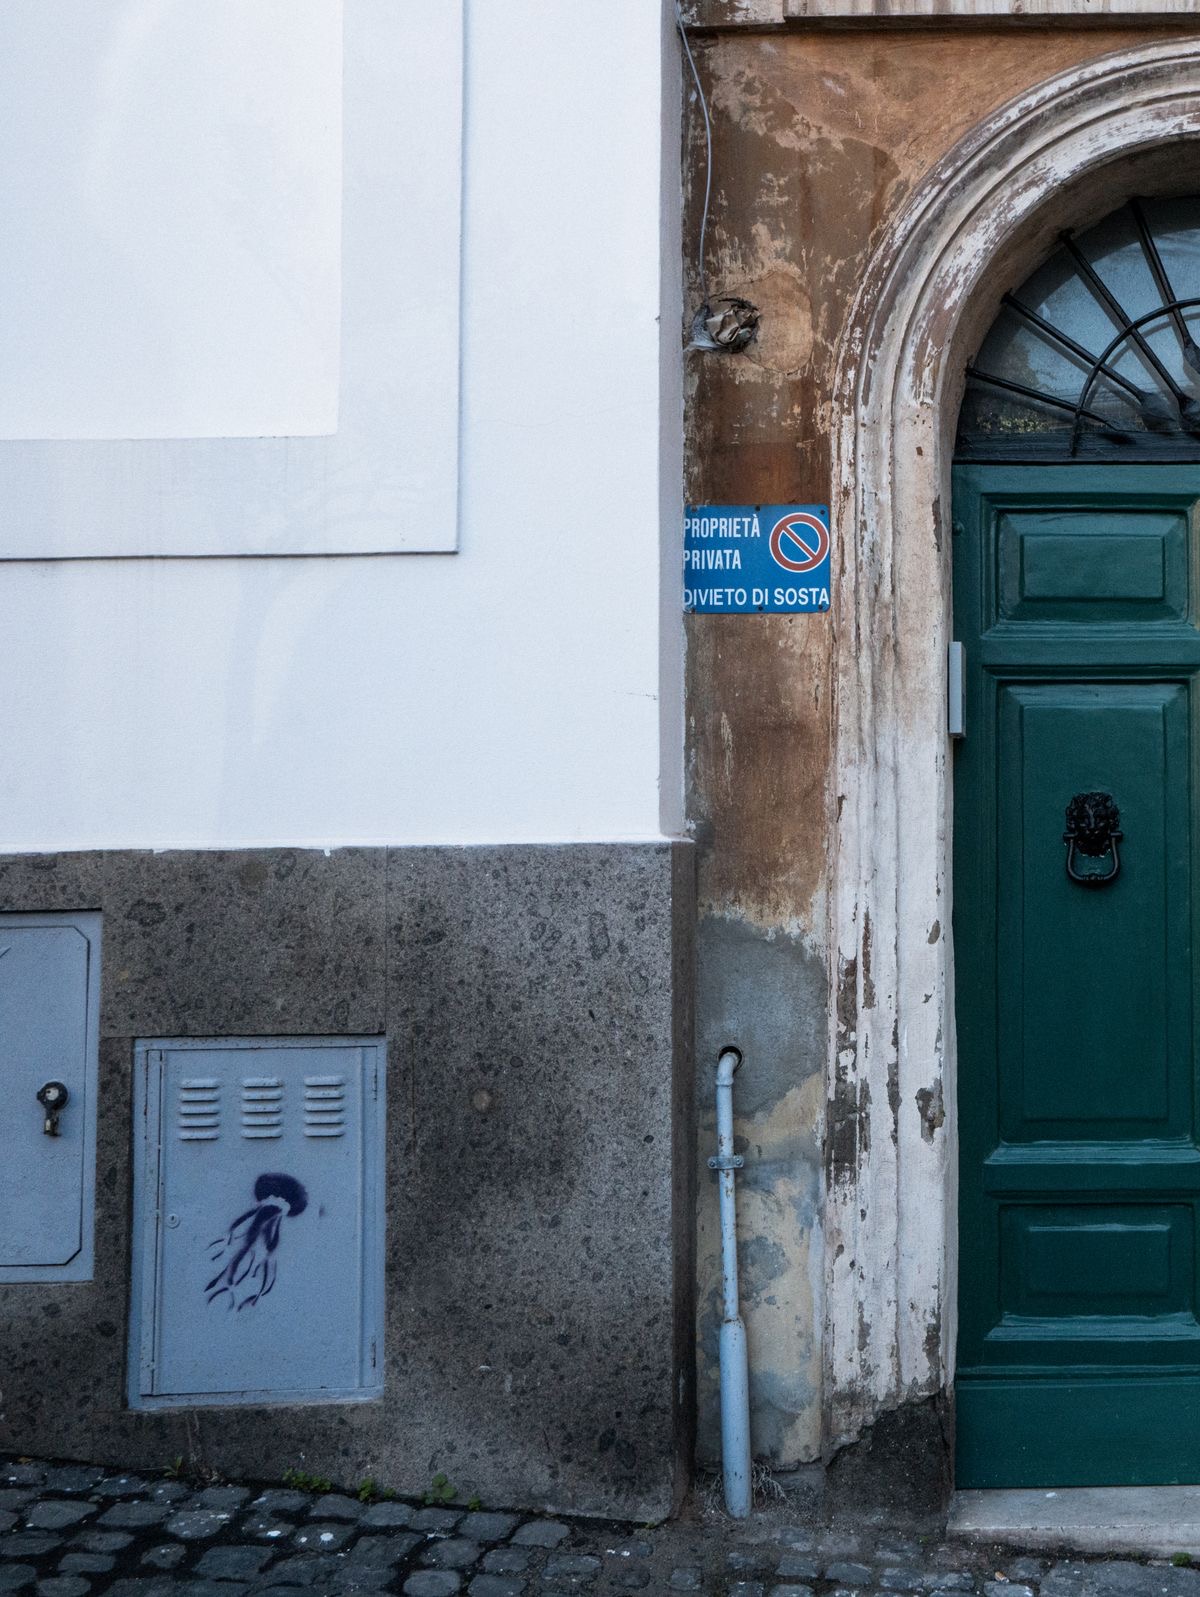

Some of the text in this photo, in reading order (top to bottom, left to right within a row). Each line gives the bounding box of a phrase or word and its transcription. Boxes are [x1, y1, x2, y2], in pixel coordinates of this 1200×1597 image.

[685, 514, 760, 538] PROPRIETÀ
[684, 549, 742, 570] PRIVATA
[684, 587, 830, 606] DIVIETO DI SOSTA
